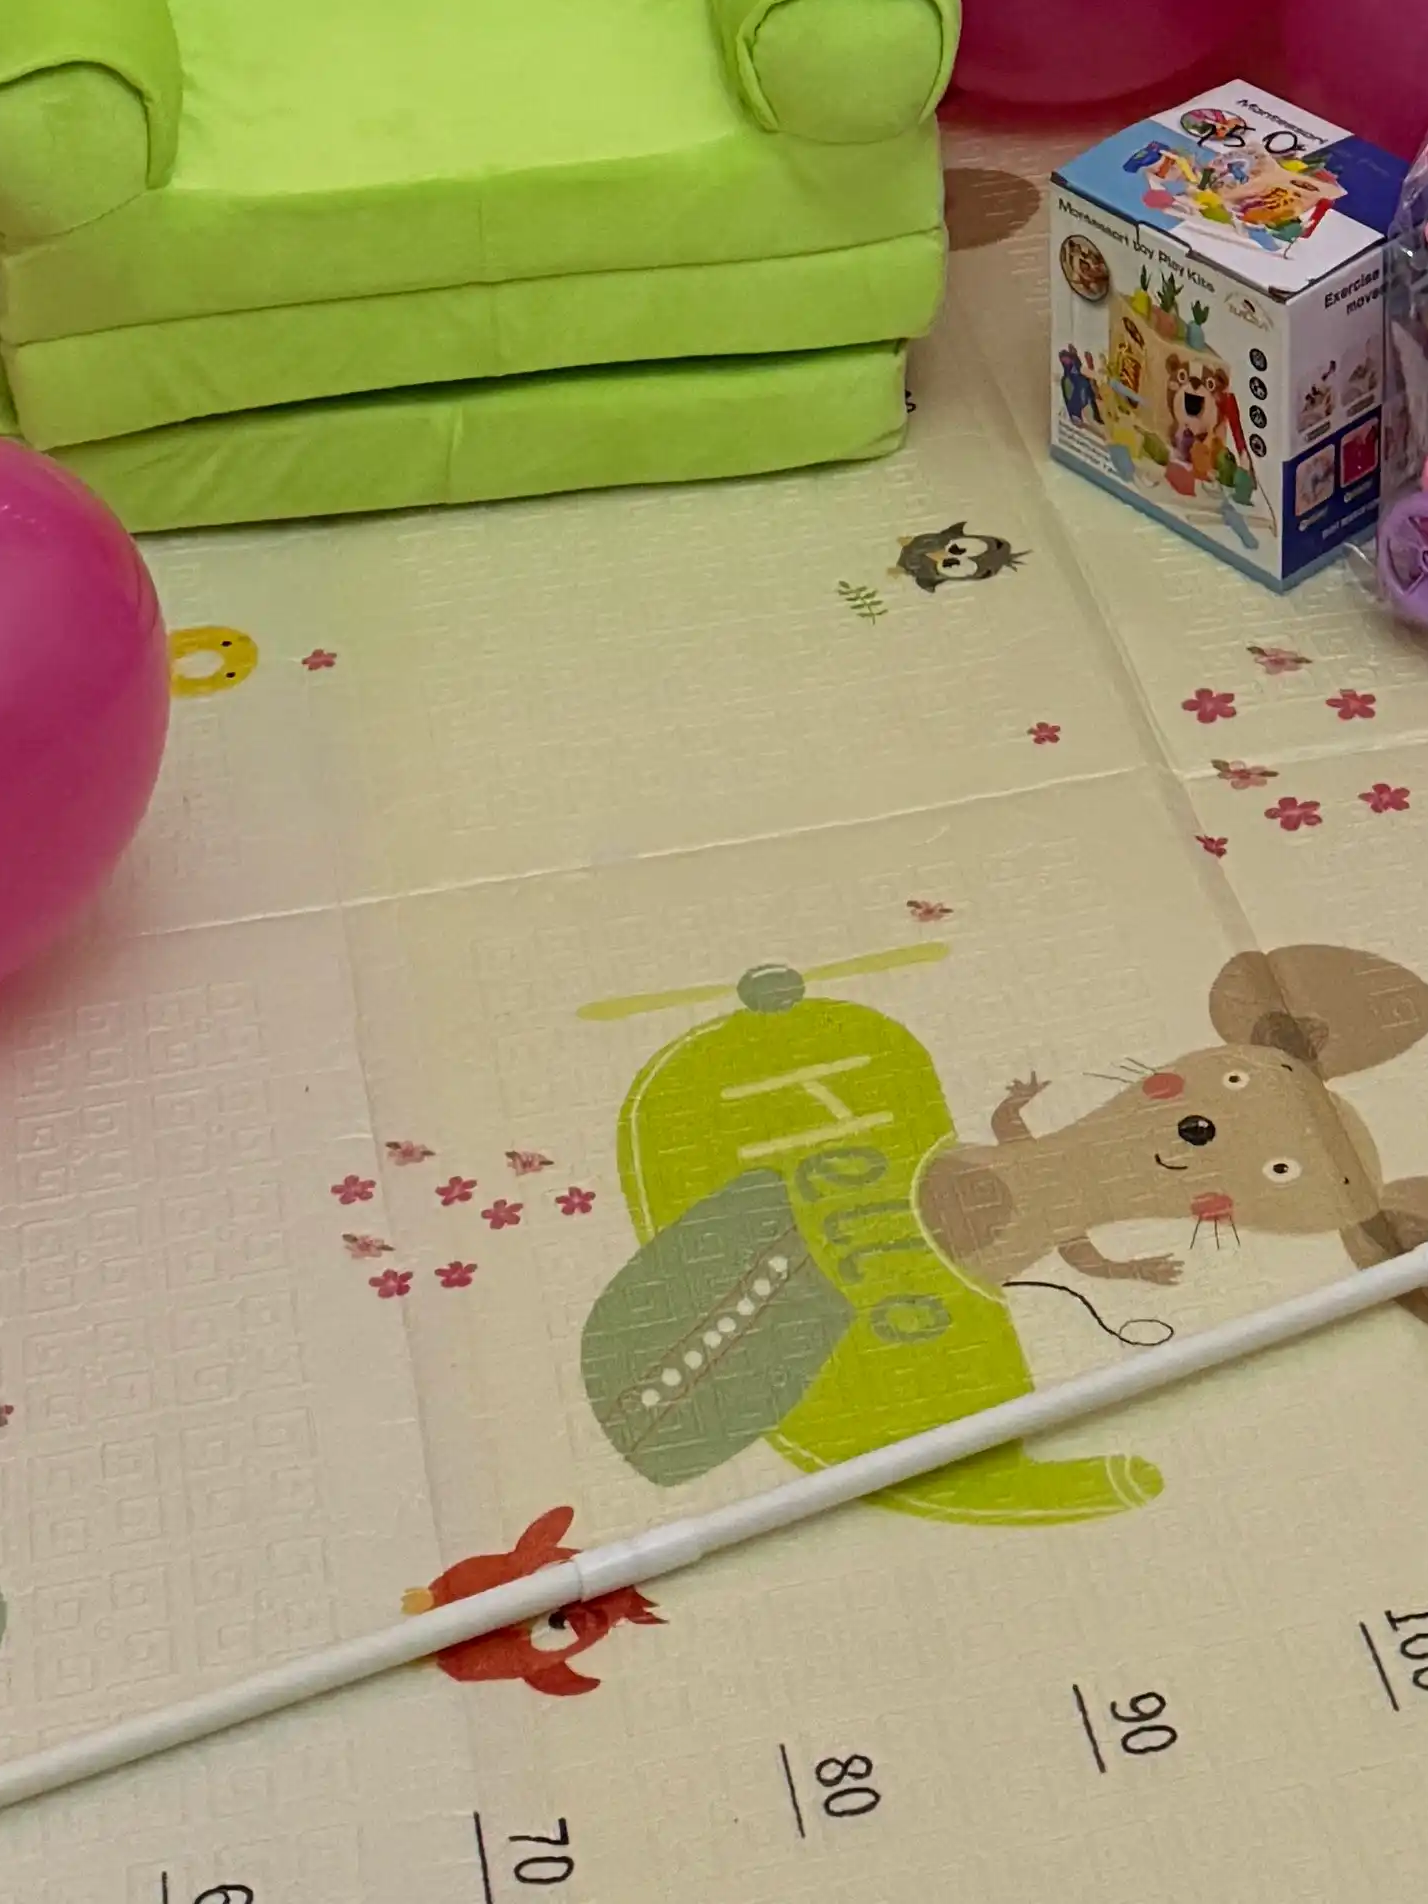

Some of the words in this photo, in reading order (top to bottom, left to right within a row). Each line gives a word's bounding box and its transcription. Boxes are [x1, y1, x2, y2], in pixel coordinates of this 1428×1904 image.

[1187, 267, 1216, 293] Kits
[1324, 268, 1381, 310] Exercise
[1109, 1690, 1179, 1756] 90
[814, 1753, 881, 1819] 80
[508, 1817, 575, 1885] 70
